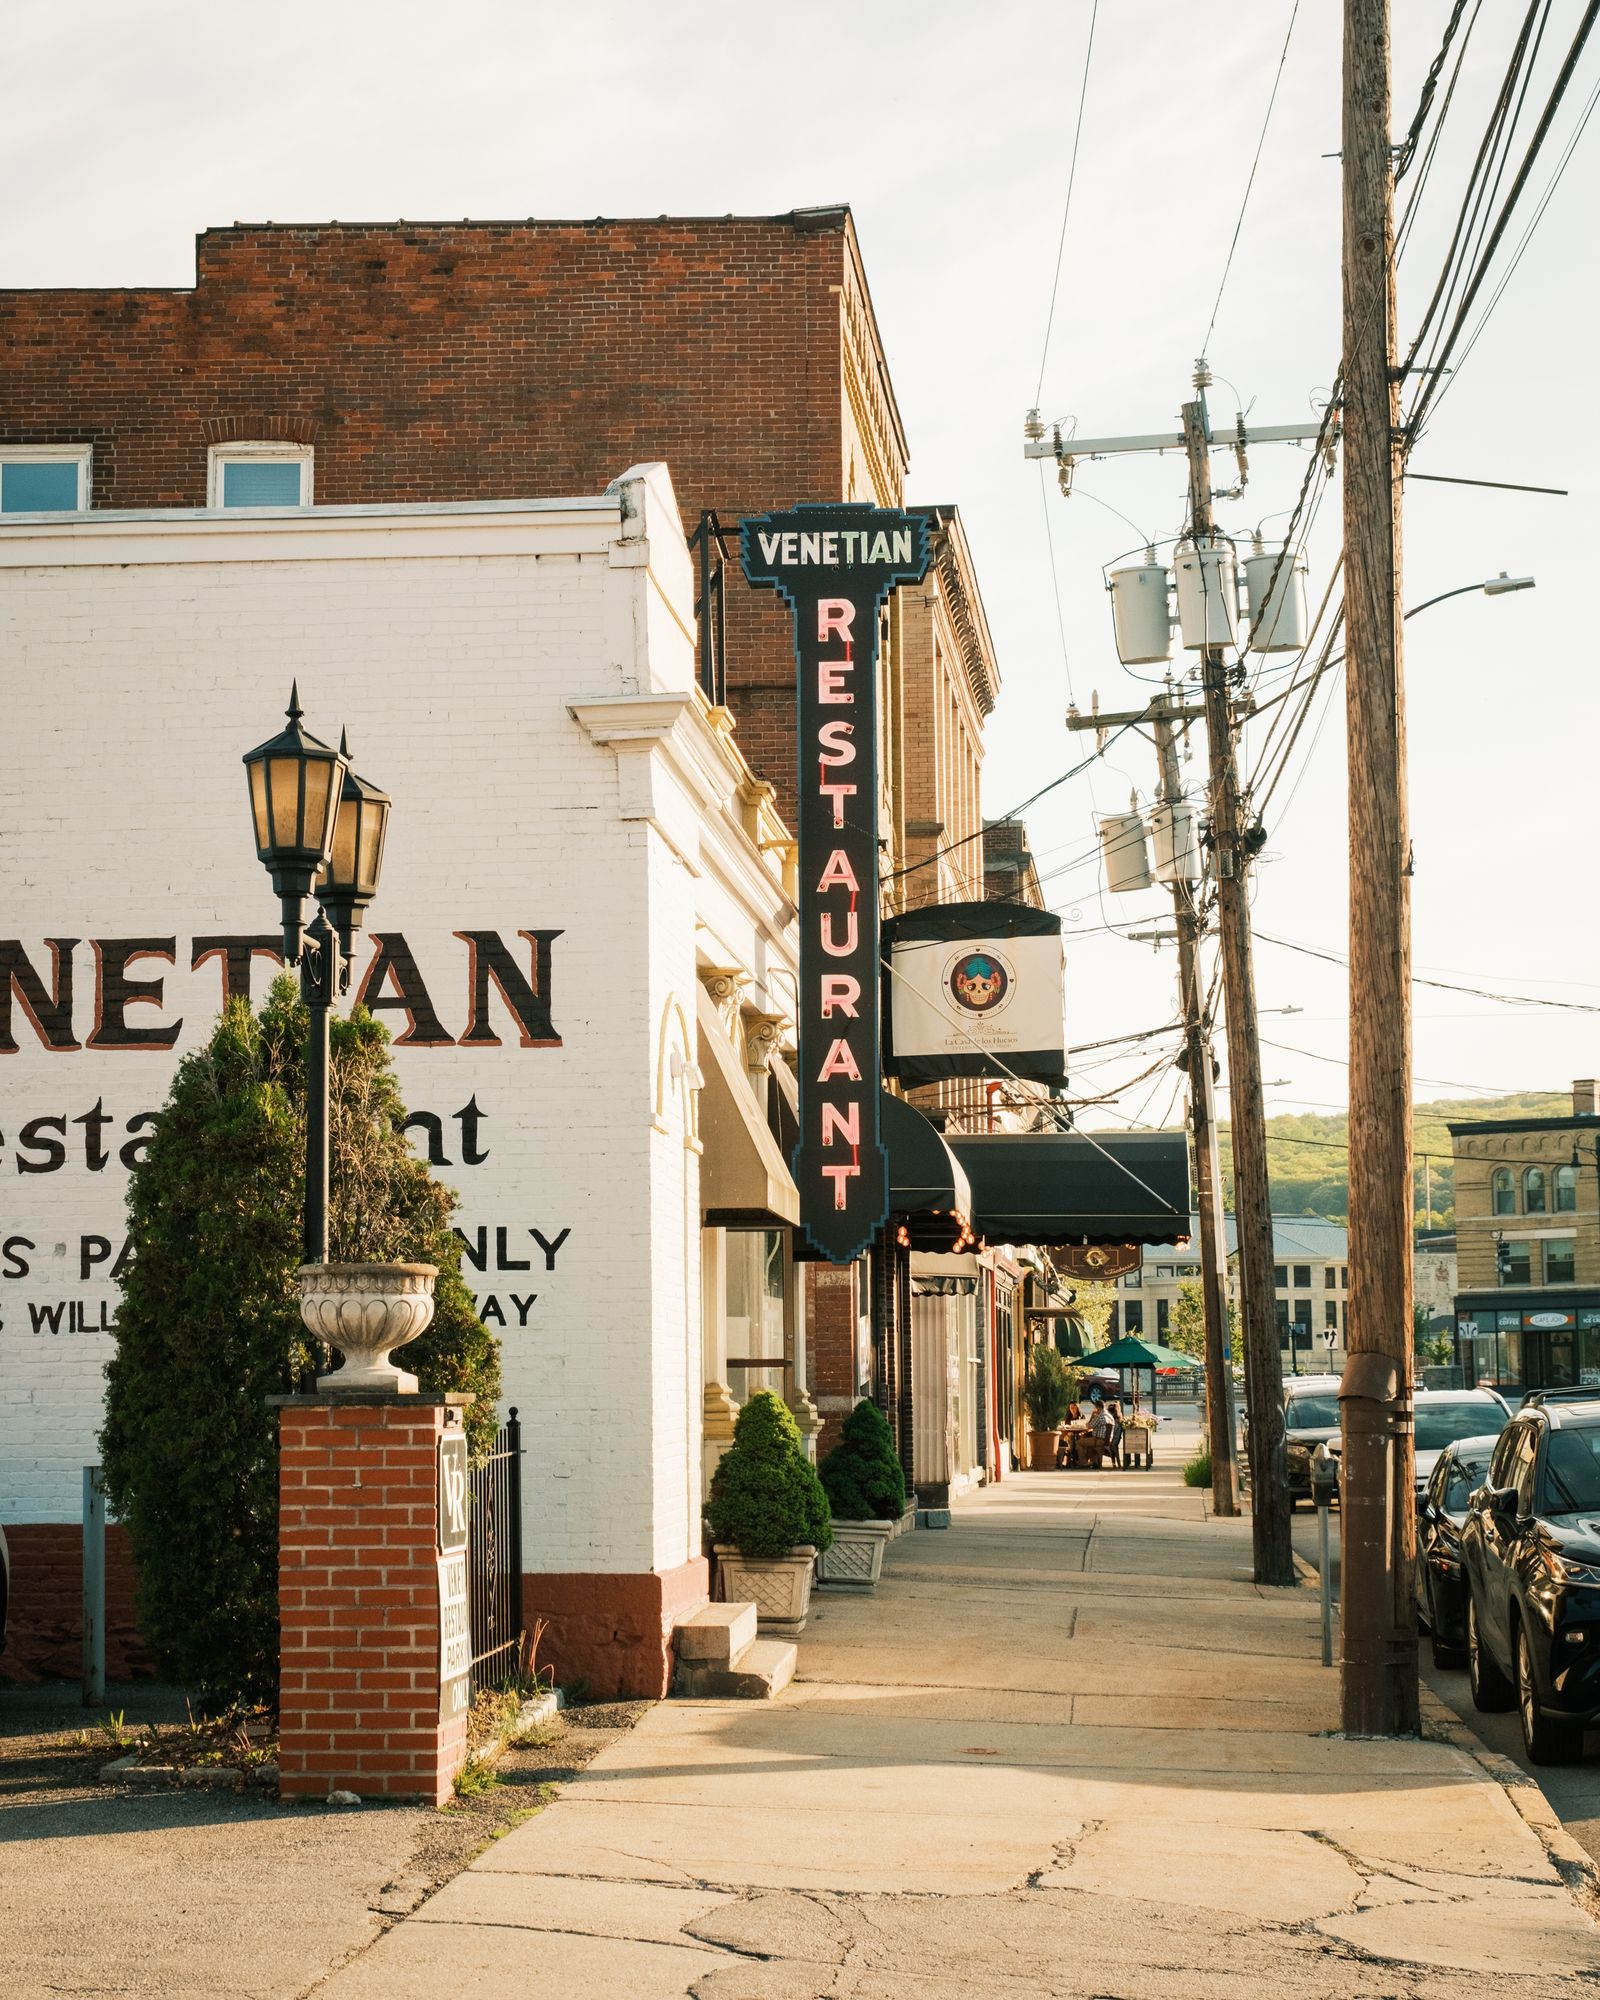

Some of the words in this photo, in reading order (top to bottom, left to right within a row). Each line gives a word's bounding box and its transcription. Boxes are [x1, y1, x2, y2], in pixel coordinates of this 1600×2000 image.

[757, 529, 912, 566] VENETIAN
[816, 598, 861, 1210] RESTAURANT
[0, 930, 565, 1054] NETAN
